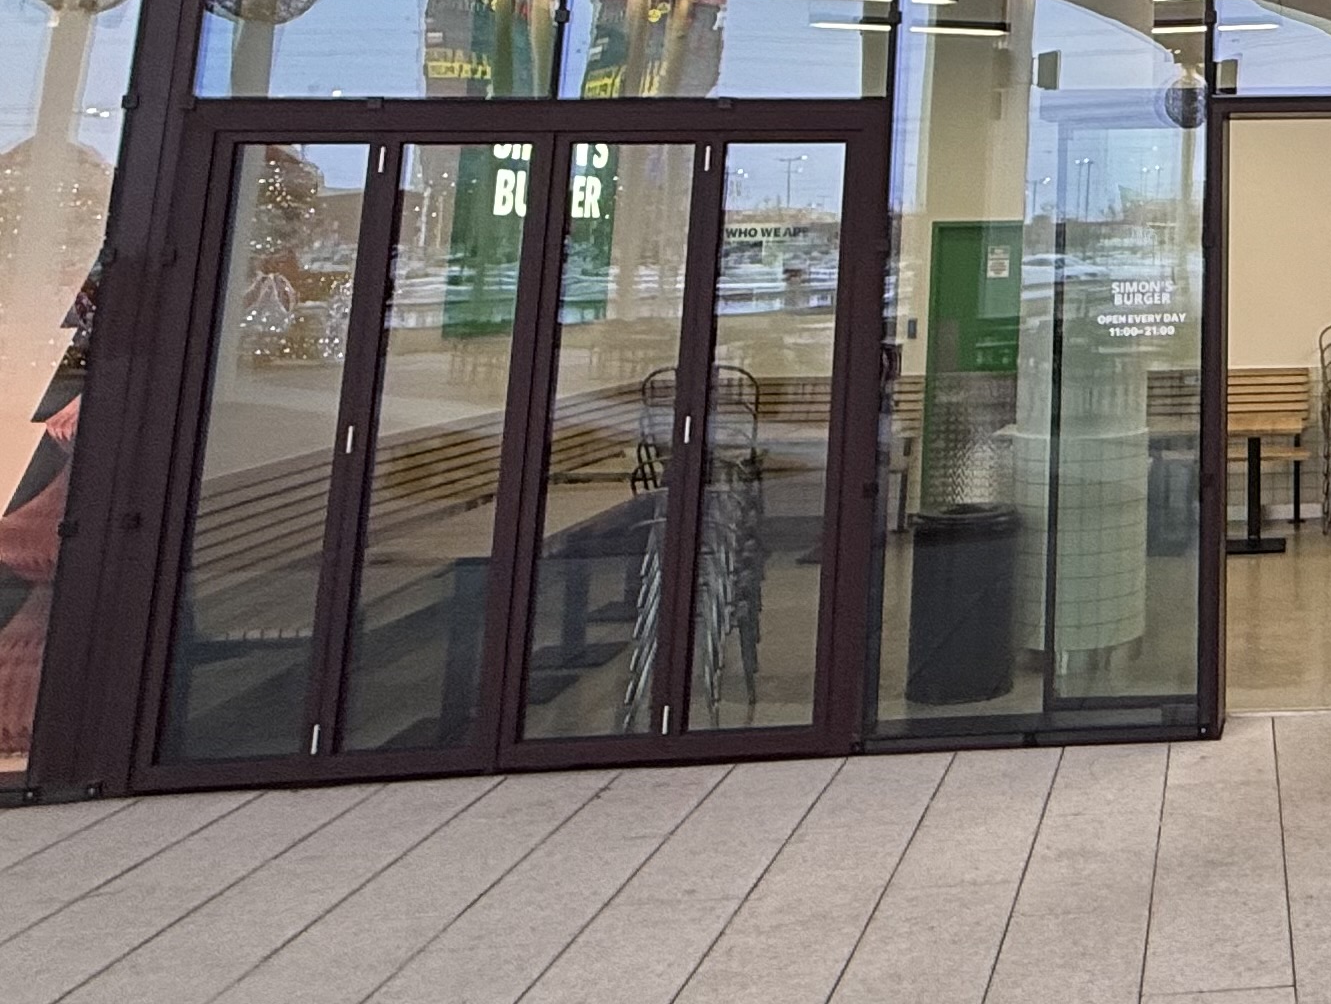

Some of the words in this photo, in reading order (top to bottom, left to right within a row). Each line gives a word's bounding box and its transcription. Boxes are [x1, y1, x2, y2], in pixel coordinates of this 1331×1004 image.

[725, 227, 758, 238] WHO
[760, 227, 780, 238] WE
[1111, 281, 1175, 294] SIMON'S
[1114, 293, 1171, 305] BURGER
[1097, 315, 1127, 325] OPEN
[1127, 313, 1161, 324] EVERY
[1163, 312, 1187, 323] DAY
